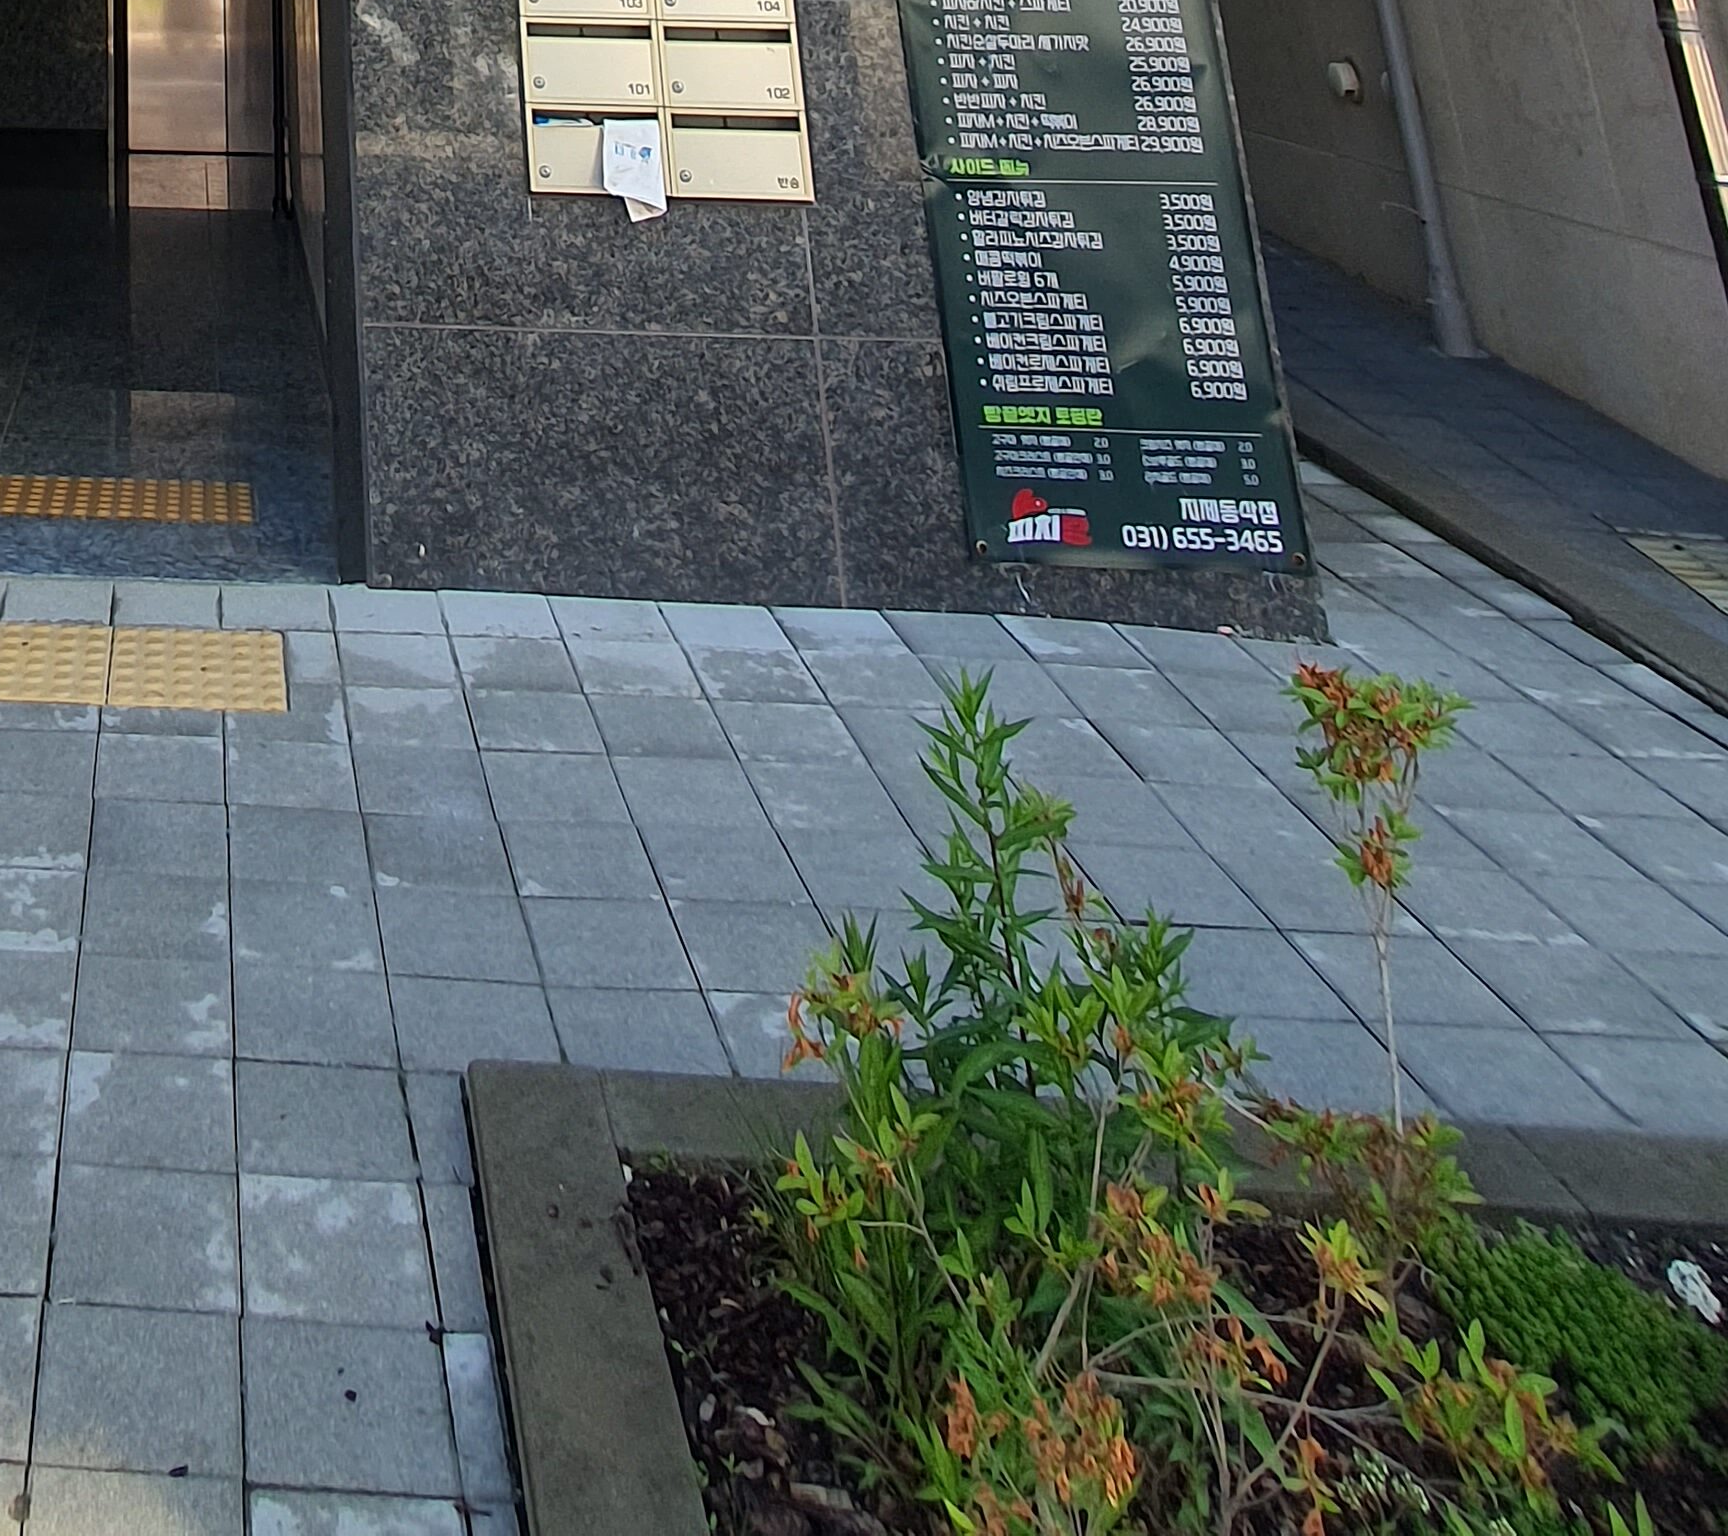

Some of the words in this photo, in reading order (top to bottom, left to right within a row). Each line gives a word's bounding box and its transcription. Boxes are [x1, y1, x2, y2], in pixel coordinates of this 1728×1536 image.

[757, 0, 781, 12] 104
[628, 84, 651, 95] 101
[766, 88, 791, 99] 102
[950, 157, 999, 175] 사이드
[999, 159, 1030, 176] 메뉴
[1122, 524, 1169, 550] 031)
[1172, 526, 1284, 553] 655-3465
